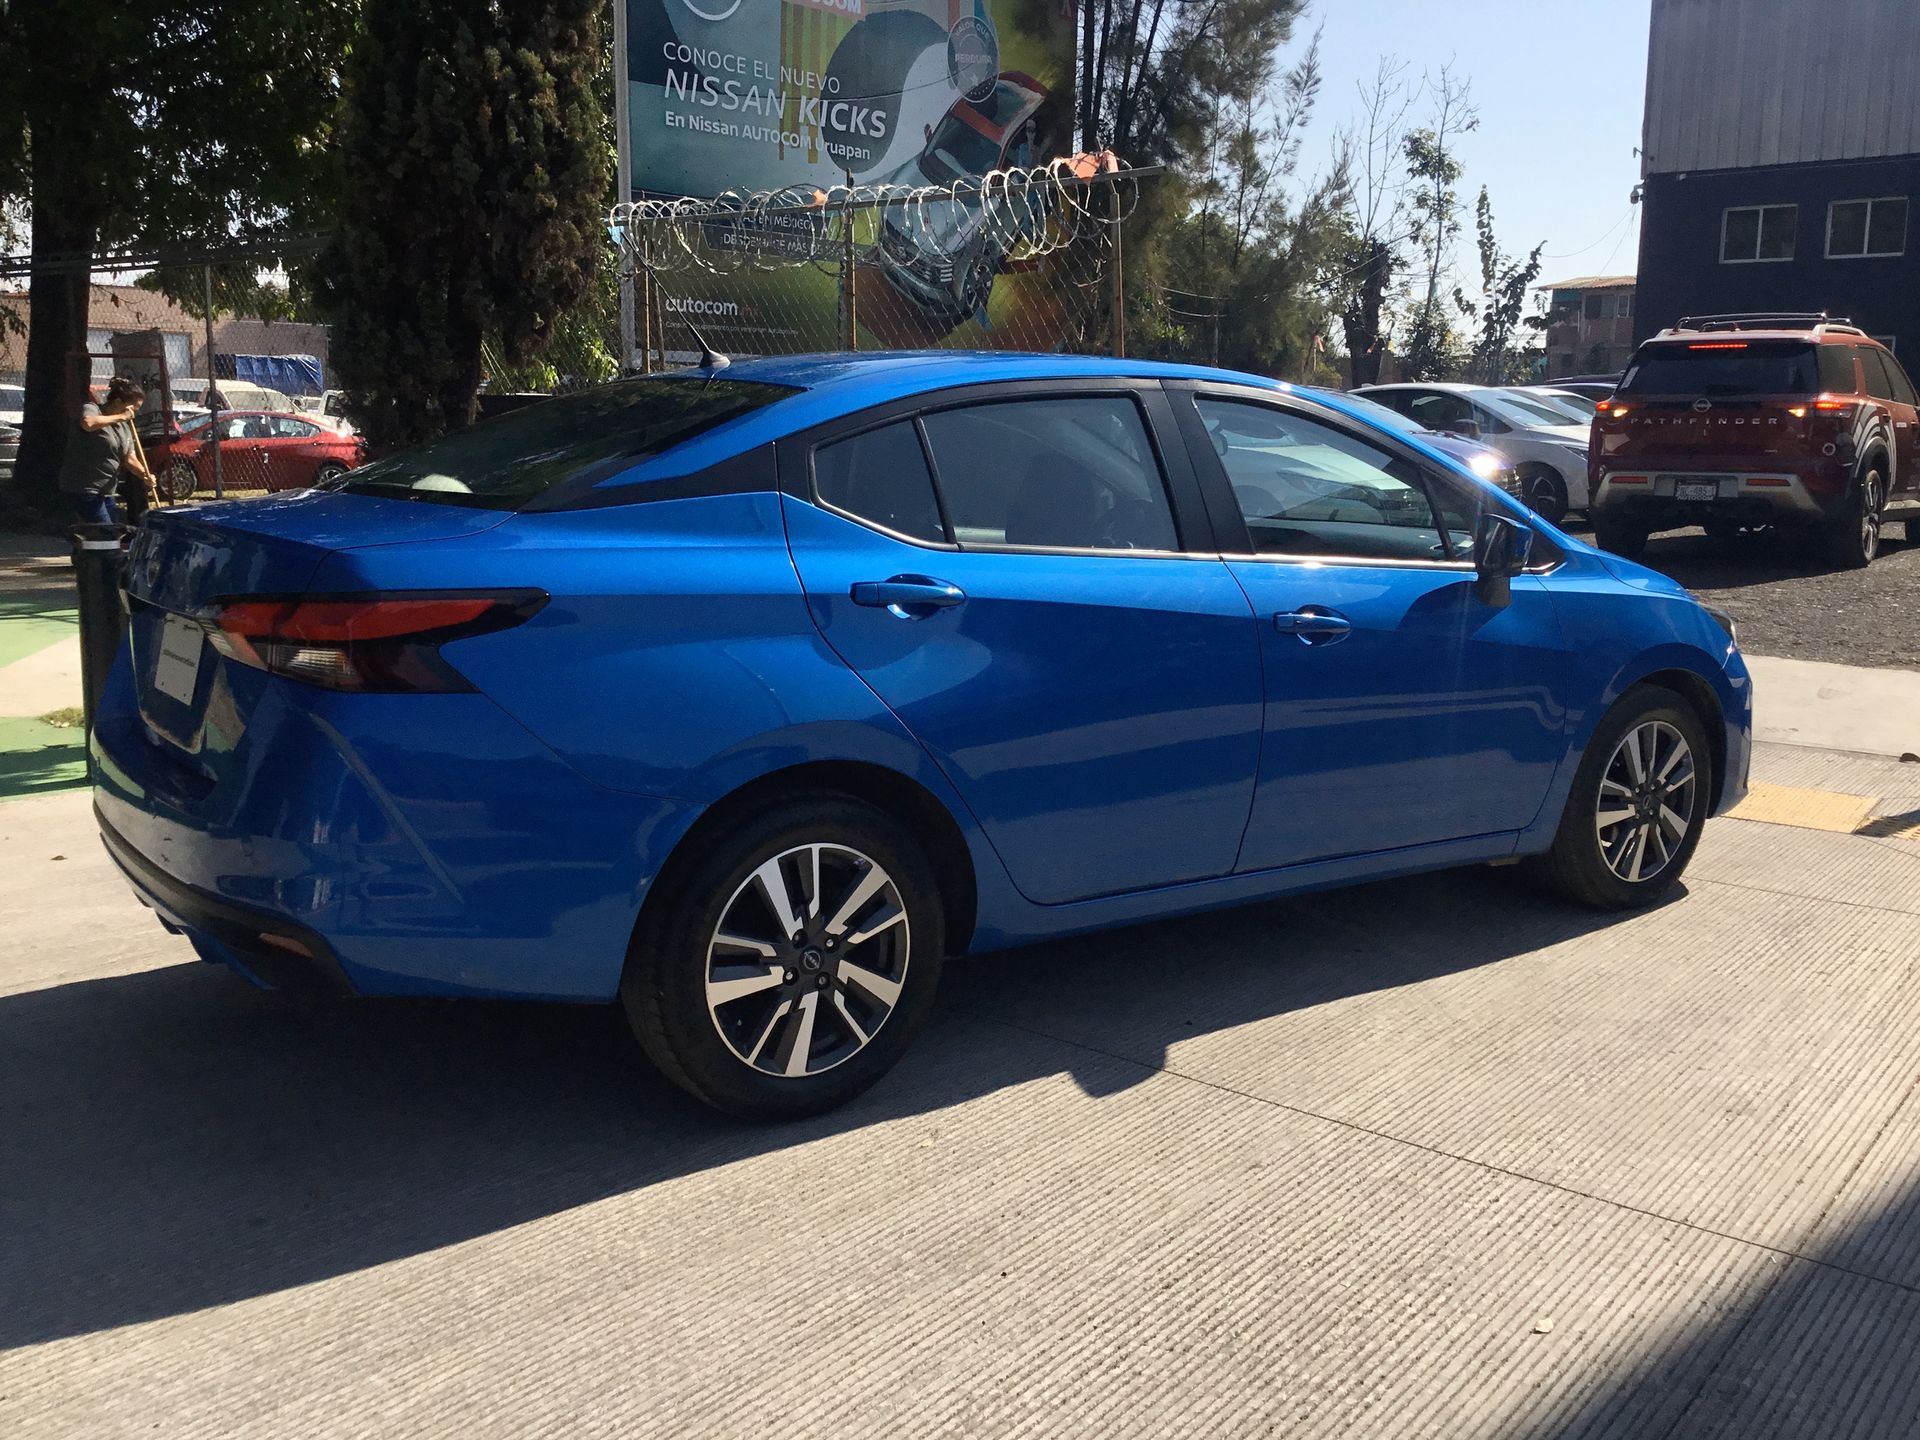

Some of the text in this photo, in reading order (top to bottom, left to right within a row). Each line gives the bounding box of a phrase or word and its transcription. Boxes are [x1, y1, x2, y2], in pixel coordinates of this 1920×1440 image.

[662, 41, 841, 94] CONOCE EL NUEVO
[954, 53, 993, 65] PERDURA
[664, 67, 888, 139] NISSAN KICKS
[665, 110, 871, 164] En Nissan AUTOCOM Uruapan
[665, 297, 738, 316] autocom
[1630, 417, 1778, 425] PATHFINDER
